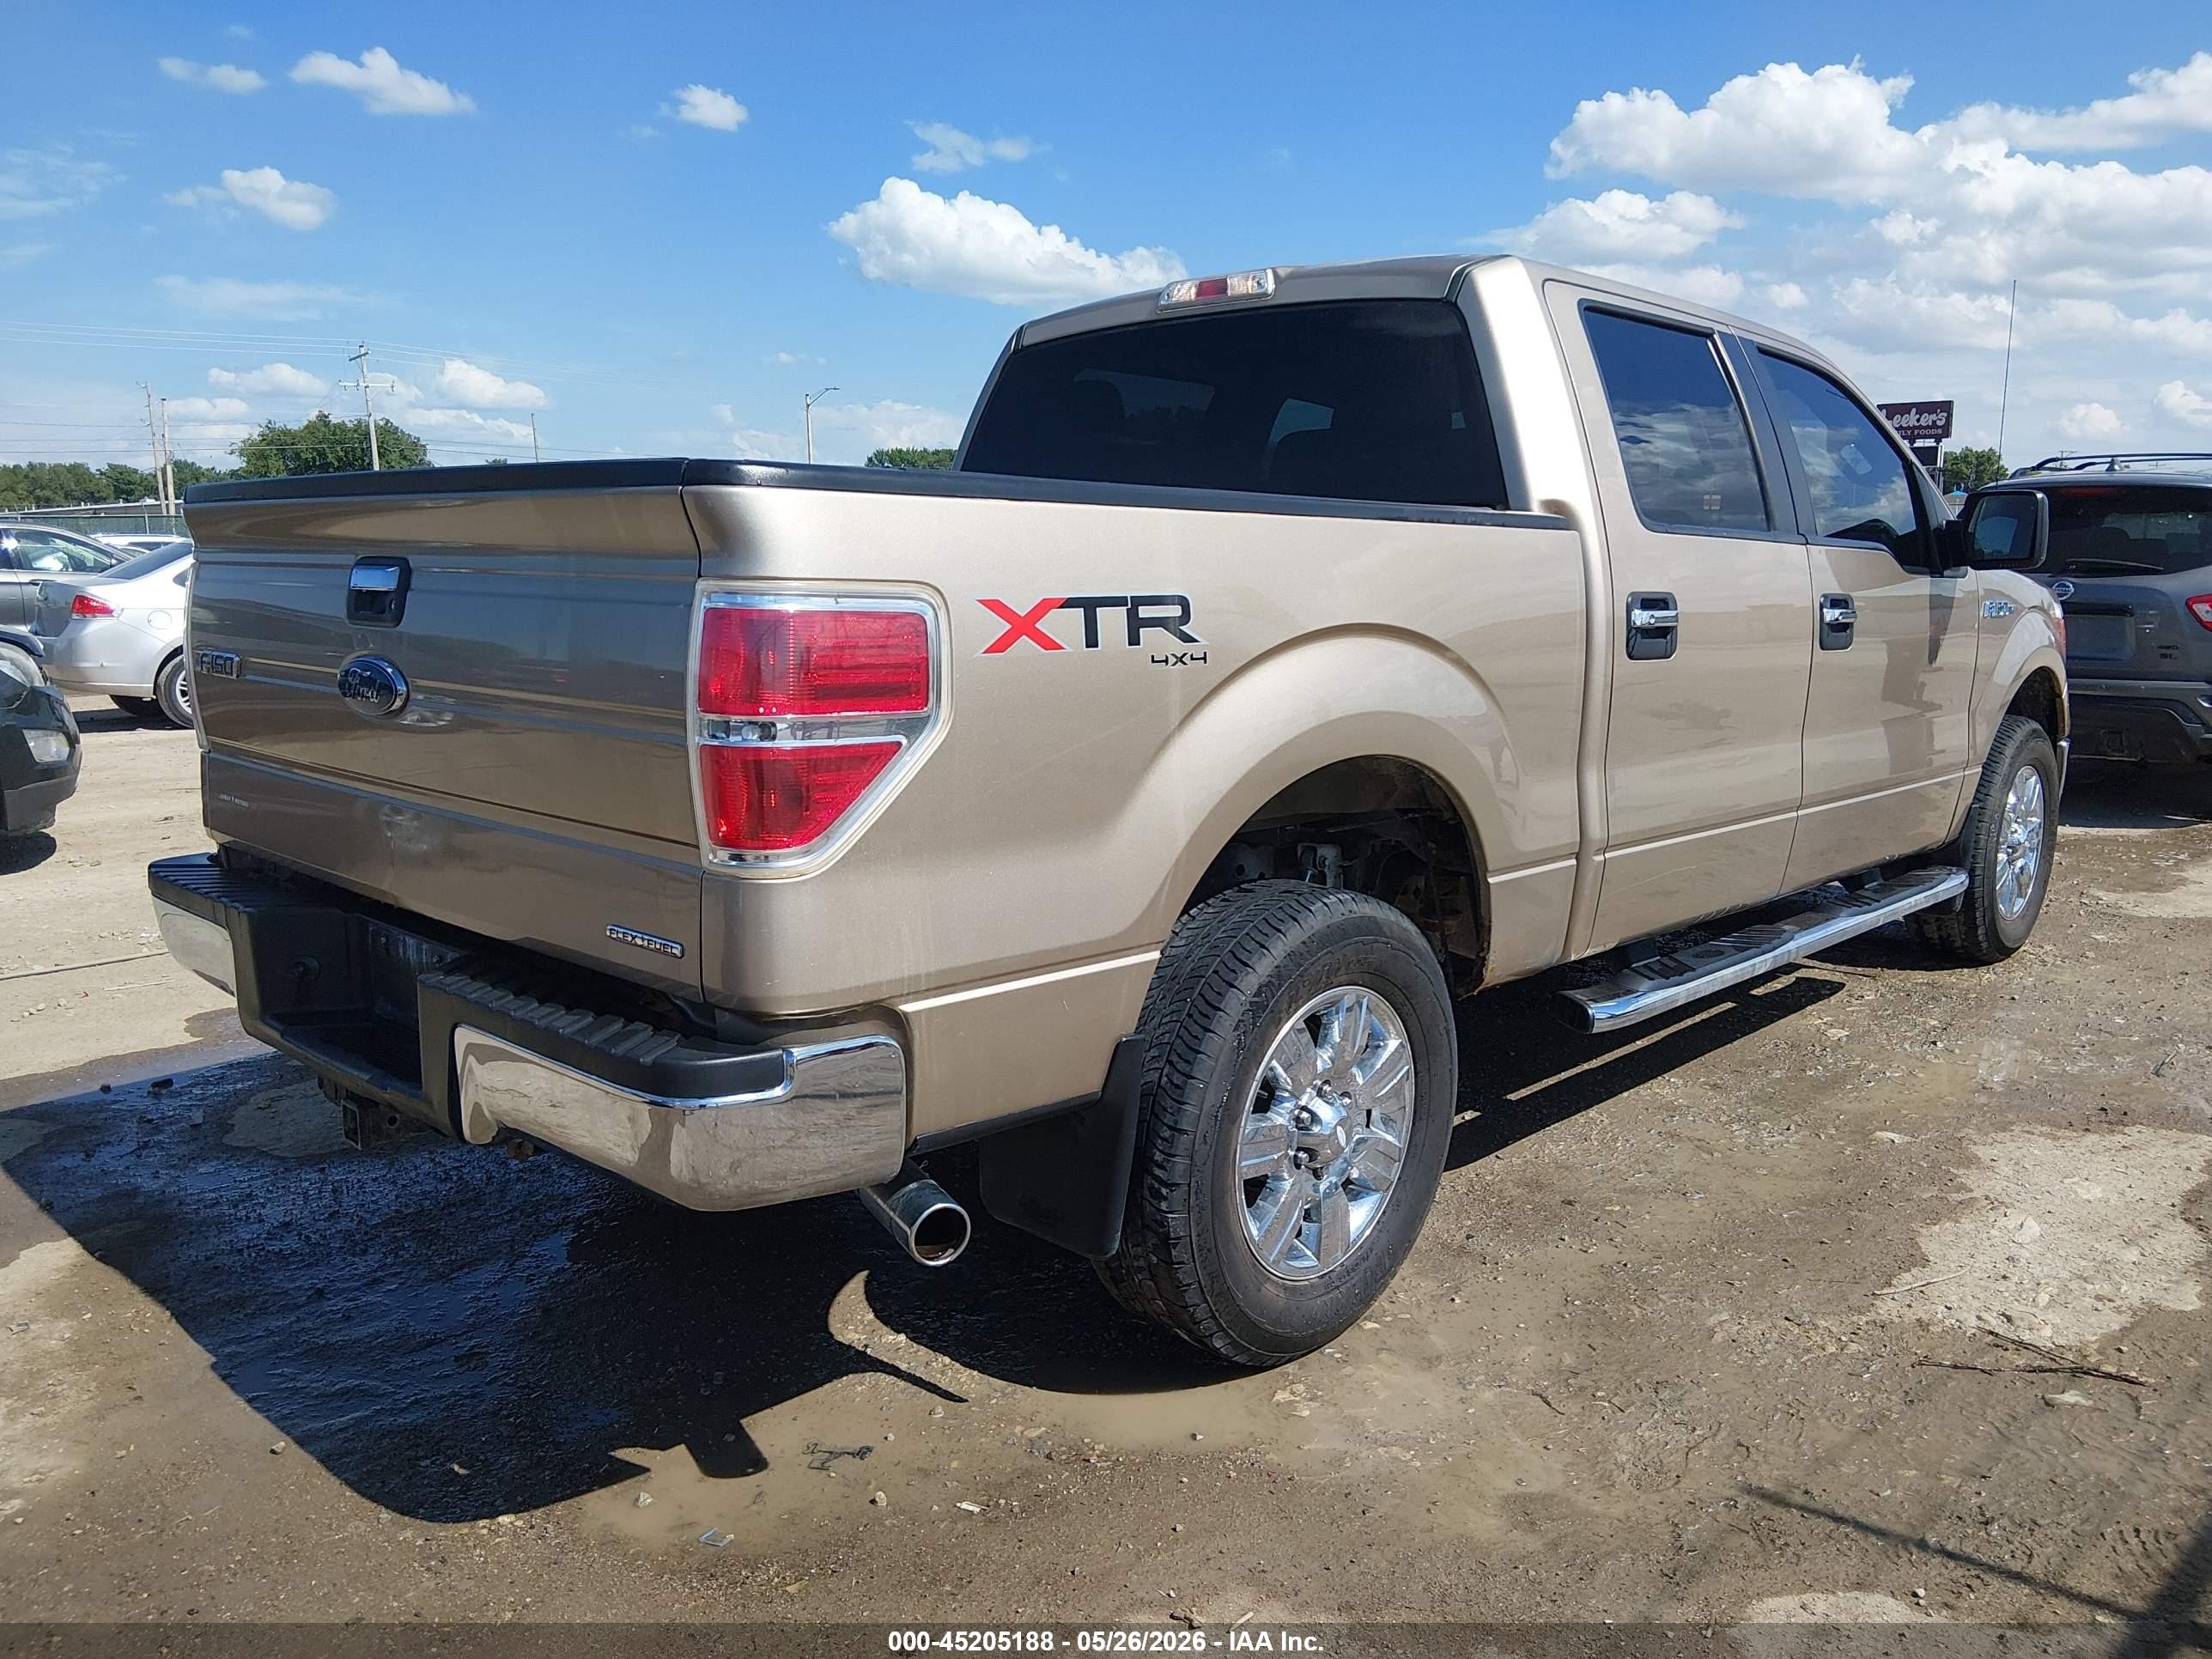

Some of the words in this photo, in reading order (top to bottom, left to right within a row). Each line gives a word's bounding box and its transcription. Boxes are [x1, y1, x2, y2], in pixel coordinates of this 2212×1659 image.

[975, 594, 1202, 654] XTR
[343, 667, 380, 703] Ford
[609, 927, 639, 947] FLEX
[646, 939, 678, 956] FUEL
